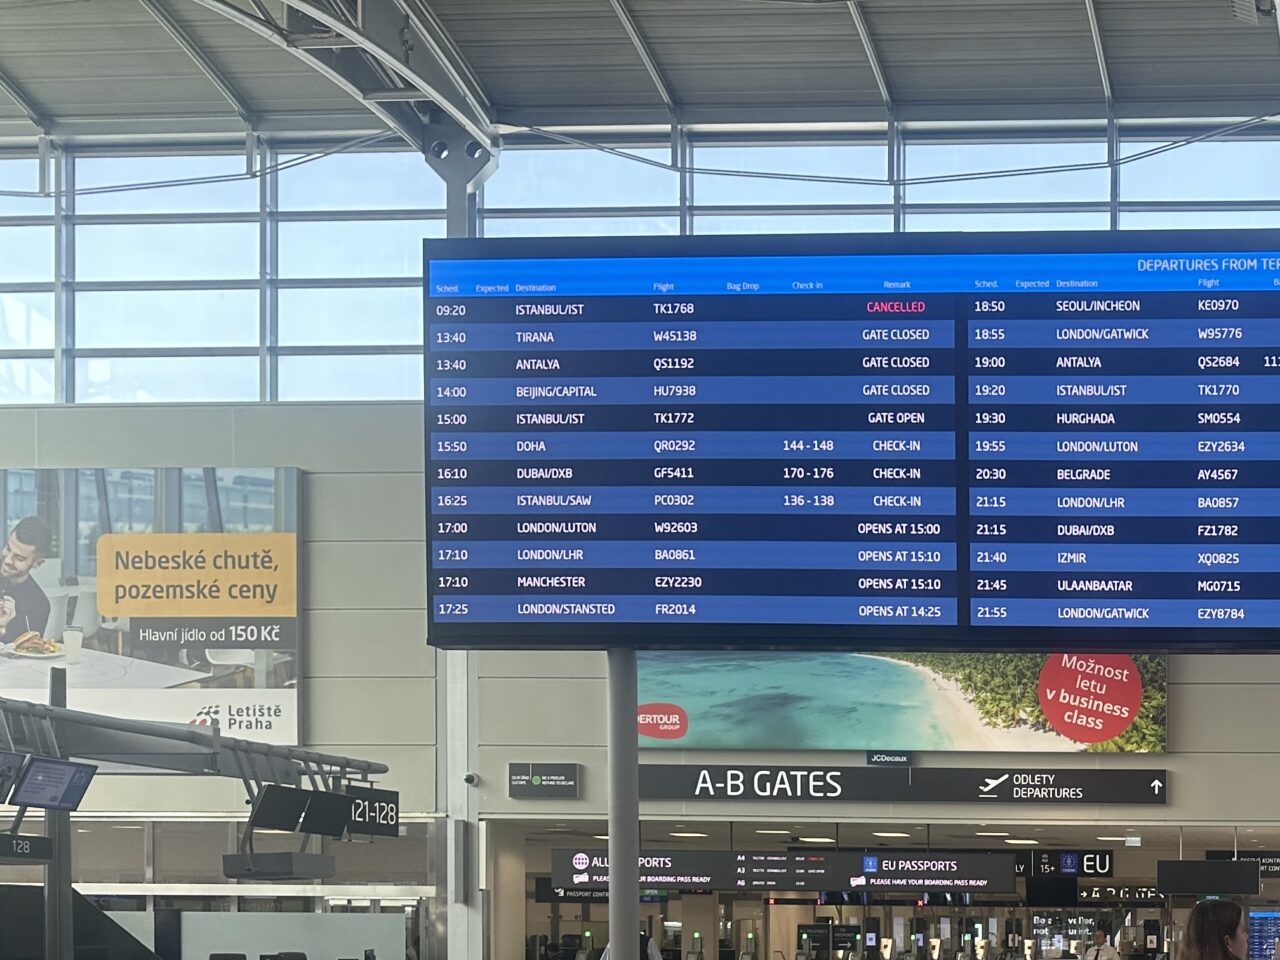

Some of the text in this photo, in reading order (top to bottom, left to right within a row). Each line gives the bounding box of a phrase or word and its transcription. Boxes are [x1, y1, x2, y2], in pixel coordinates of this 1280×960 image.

[1137, 258, 1219, 272] DEPARTURES
[1221, 258, 1258, 271] FROM
[515, 301, 926, 316] ISTANBUL/IST TK1768 CANCELLED
[1056, 299, 1240, 312] SEOUL/INCHEON KE0970
[515, 330, 697, 343] TIRANA W45138
[1056, 327, 1243, 340] LONDON/GATWICK W95776
[515, 357, 695, 371] ANTALYA QS1192
[1056, 356, 1240, 370] ANTALYA QS2684
[516, 385, 697, 400] BEIJING/CAPITAL HU7938
[1056, 384, 1240, 396] ISTANBUL/IST TK1770
[516, 412, 695, 425] ISTANBUL/IST TK1772
[1056, 412, 1241, 424] HURGHADA SM0554
[516, 439, 696, 454] DOHA QR0292
[1056, 440, 1246, 452] LONDON/LUTON EZY2634
[516, 467, 694, 479] DUBAI/DXB GF5411
[1056, 468, 1239, 480] BELGRADE AY4567
[516, 494, 695, 506] ISTANBUL/SAW PC0302
[1057, 496, 1240, 509] LONDON/LHR BA0857
[517, 522, 597, 533] LONDON/LUTON
[1057, 524, 1239, 536] DUBAI/DXB FZ1782
[115, 548, 279, 573] Nebeské chutě,
[517, 549, 696, 560] LONDON/LHR BA0861
[1057, 552, 1087, 564] IZMIR
[517, 576, 702, 588] MANCHESTER EZY2230
[1057, 579, 1241, 592] ULAANBAATAR MG0715
[114, 578, 279, 605] pozemské ceny
[517, 603, 697, 615] LONDON/STANSTED FR2014
[1057, 607, 1150, 619] LONDON/GATWICK
[139, 624, 280, 644] Hlavní jídlo od 150 Kč
[1061, 653, 1129, 682] Možnost
[1076, 674, 1107, 695] letu
[1046, 688, 1130, 718] v business
[228, 704, 282, 718] Letiště
[228, 717, 273, 730] Praha
[1063, 709, 1104, 730] class
[871, 754, 908, 762] JCDecaux
[694, 769, 842, 797] A-B GATES
[1013, 773, 1056, 785] ODLETY
[1013, 787, 1083, 799] DEPARTURES
[351, 799, 397, 825] 121-128
[12, 839, 30, 853] 128
[591, 856, 609, 868] ALL
[639, 857, 672, 868] PORTS
[882, 859, 958, 872] EU PASSPORTS
[1083, 854, 1110, 874] EU
